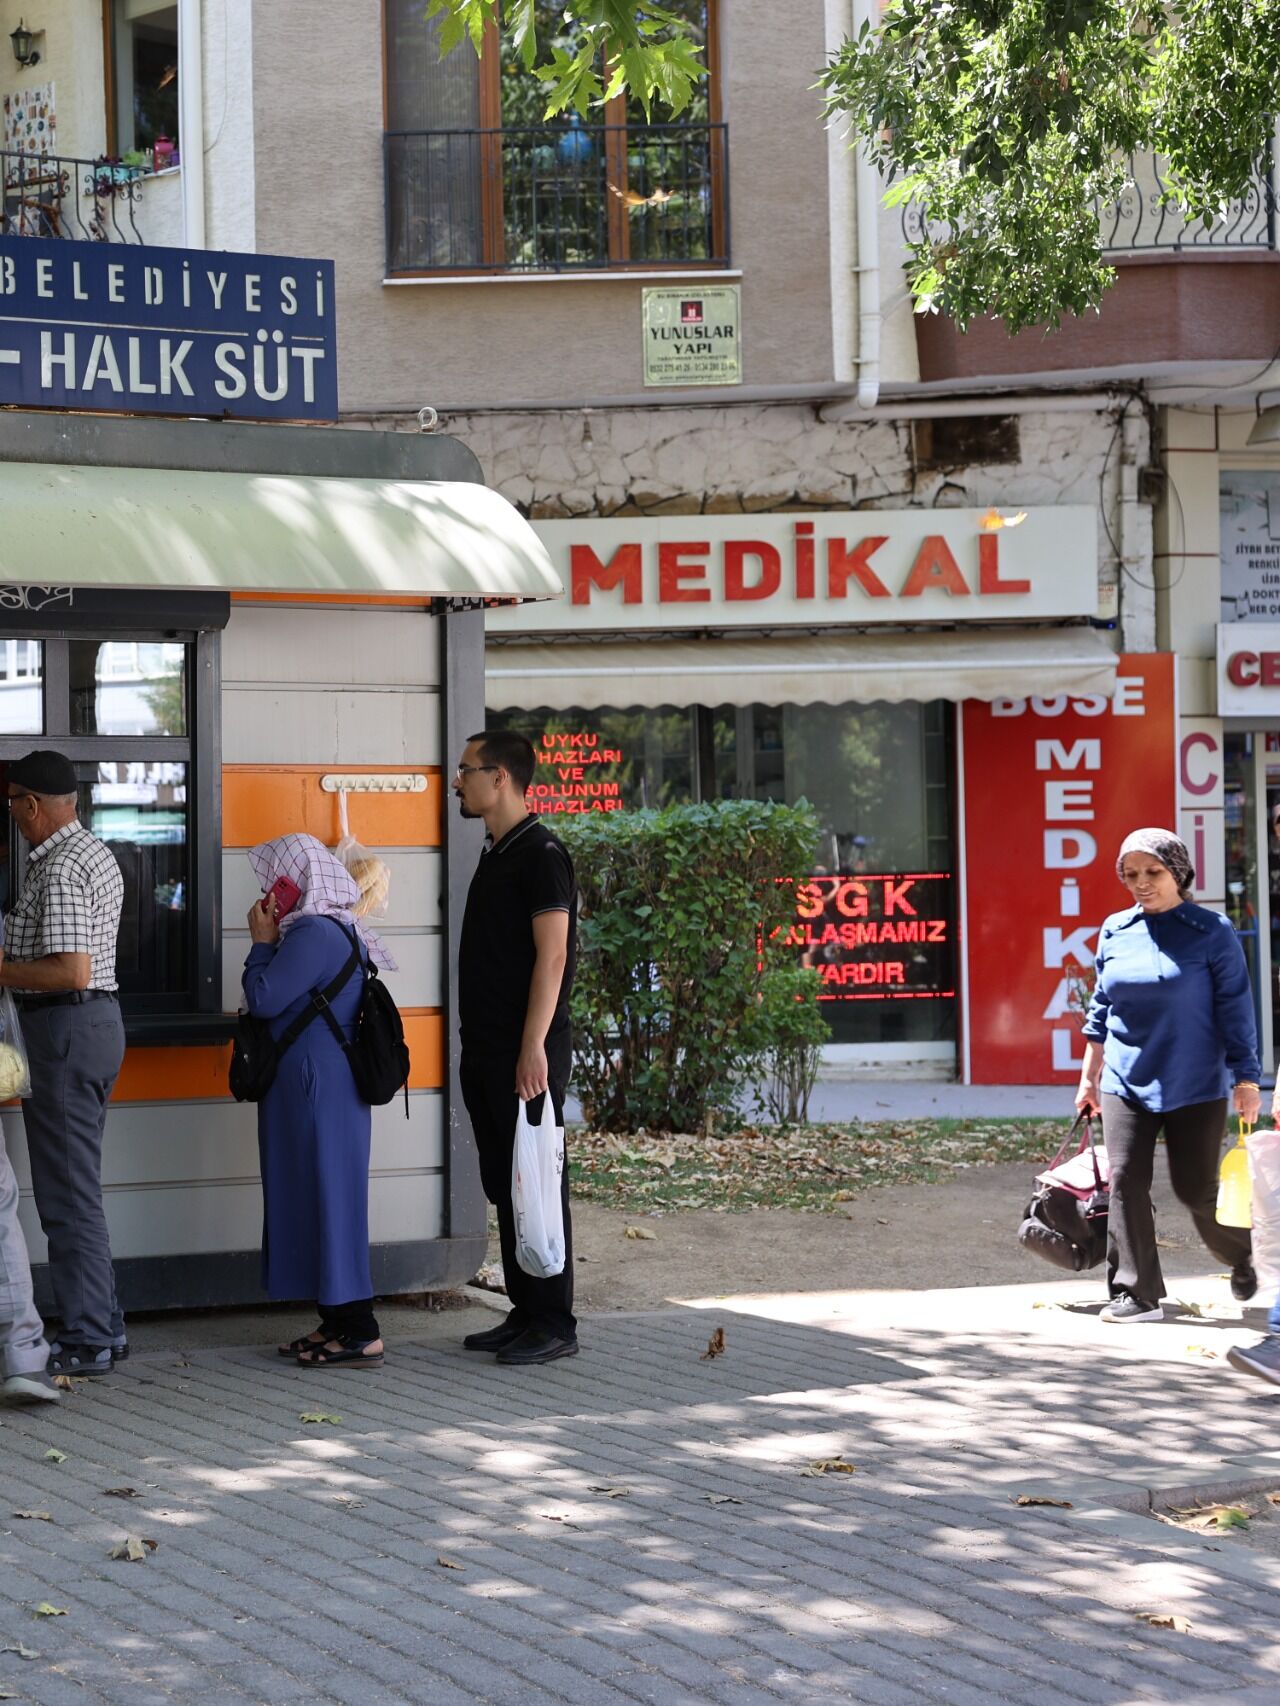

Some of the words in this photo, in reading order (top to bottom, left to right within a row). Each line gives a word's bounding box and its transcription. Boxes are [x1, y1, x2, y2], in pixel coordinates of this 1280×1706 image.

[650, 325, 734, 340] YUNUSLAR
[673, 342, 712, 355] YAPI
[39, 330, 195, 397] HALK
[214, 328, 325, 404] SÜT
[568, 520, 1032, 607] MEDİKAL
[1227, 650, 1280, 689] CE
[542, 733, 598, 748] UYKU
[558, 767, 584, 780] VE
[525, 782, 619, 797] SOLUNUM
[1034, 738, 1102, 1072] MEDİKAL
[769, 920, 947, 950] NLAŞMAMIZ
